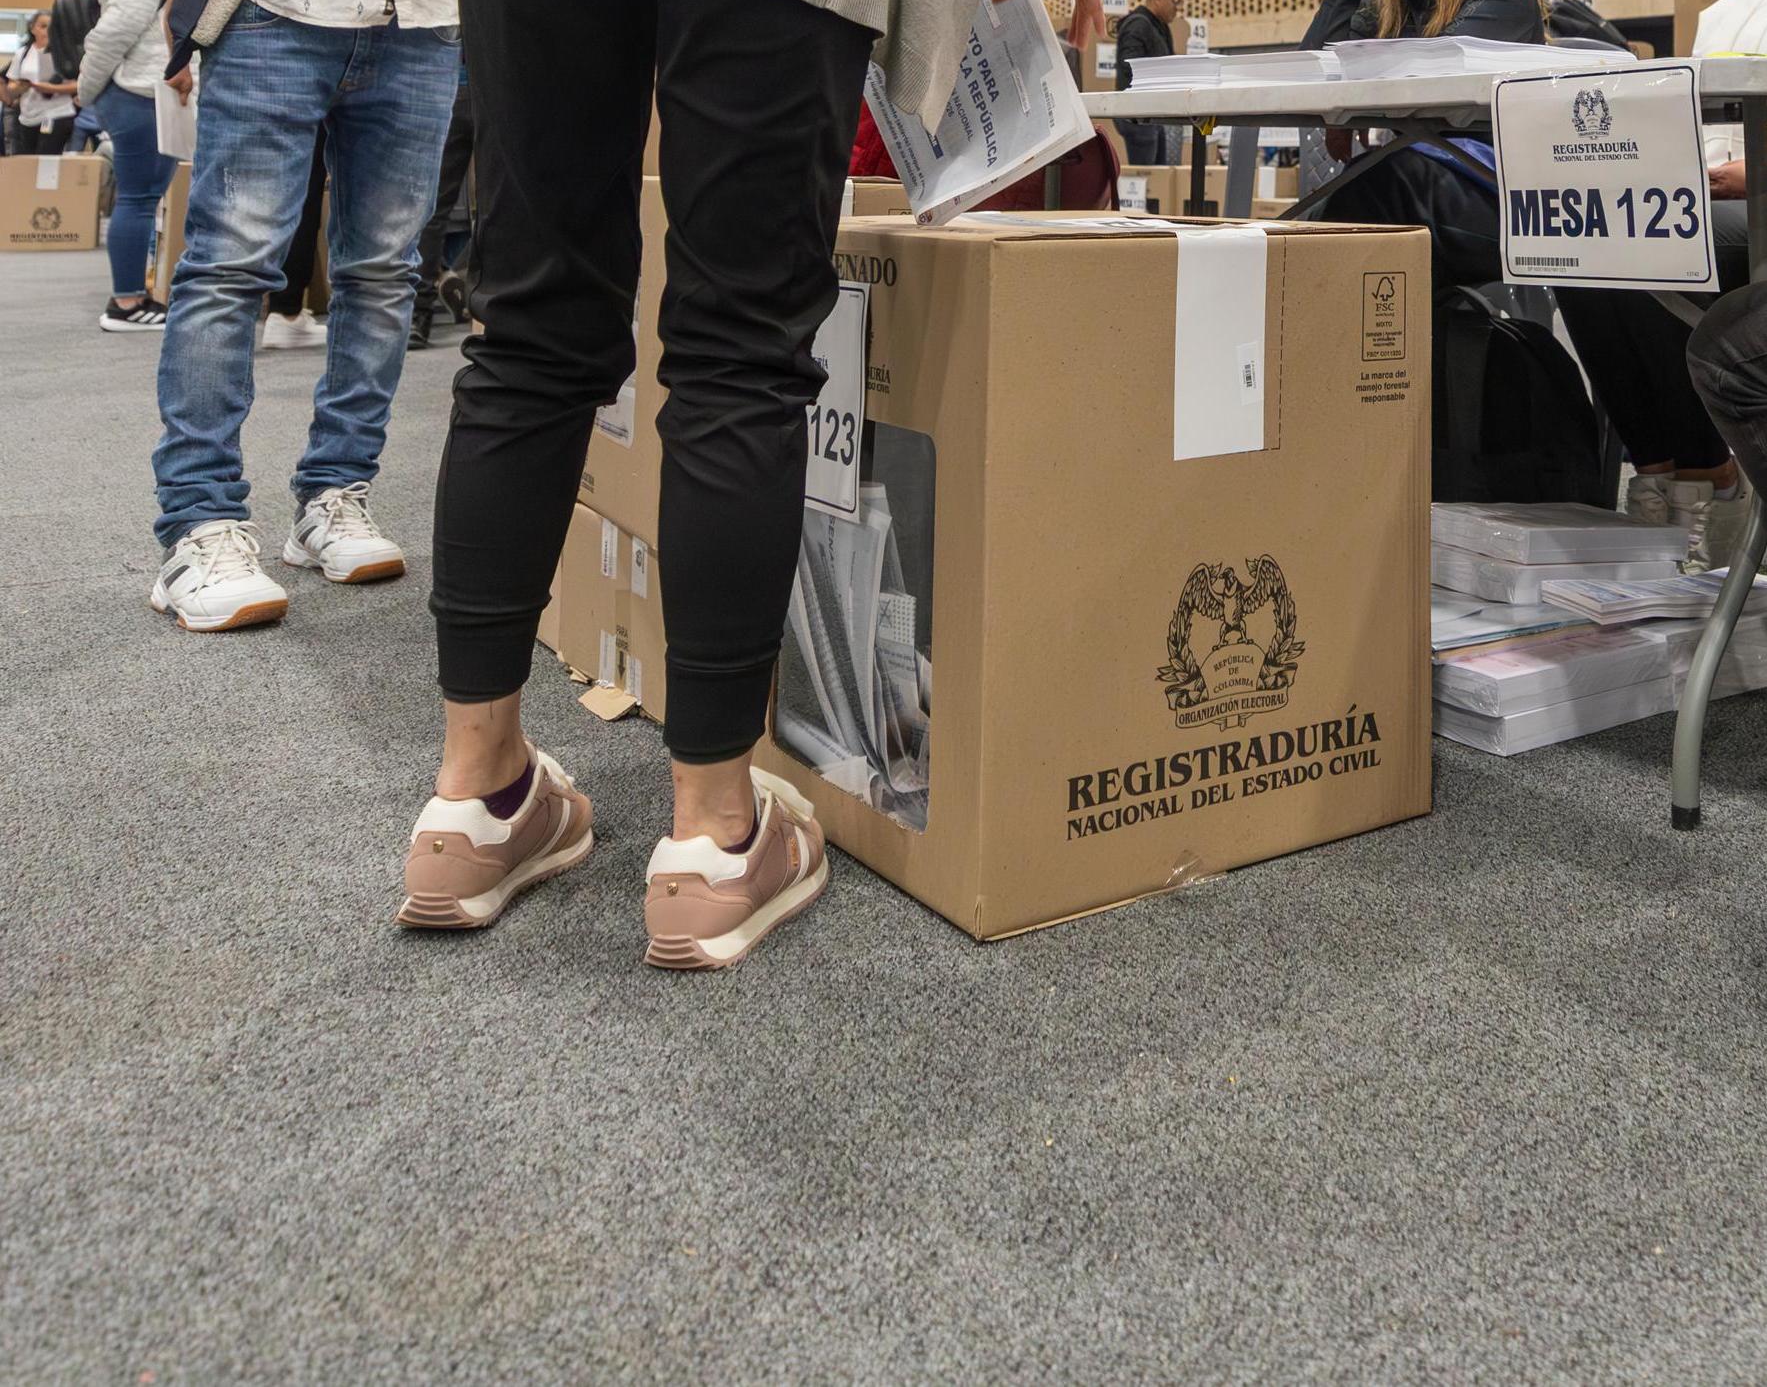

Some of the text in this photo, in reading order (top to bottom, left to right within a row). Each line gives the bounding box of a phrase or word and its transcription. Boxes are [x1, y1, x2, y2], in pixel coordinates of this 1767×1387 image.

[968, 26, 1001, 103] TO PARA
[954, 95, 975, 143] NACIONAL
[968, 79, 998, 168] REPÚBLICA
[1552, 138, 1639, 155] REGISTRADURÍA
[1553, 155, 1583, 163] NACIONAL
[1509, 187, 1700, 240] MESA 123
[833, 254, 898, 287] ENADO
[1375, 303, 1395, 312] FSC
[1355, 381, 1410, 393] manejo forestal
[1361, 370, 1407, 380] La marca del
[1361, 392, 1406, 404] responsable
[810, 405, 856, 466] 123
[1213, 654, 1255, 672] REPÚBLICA
[1228, 667, 1239, 675] DE
[1213, 678, 1254, 693] COLOMBIA
[1179, 693, 1285, 725] ORGANIZACIÓN ELECTORAL
[1066, 704, 1382, 812] REGISTRADURÍA
[1066, 749, 1382, 841] NACIONAL DEL ESTADO CIVIL
